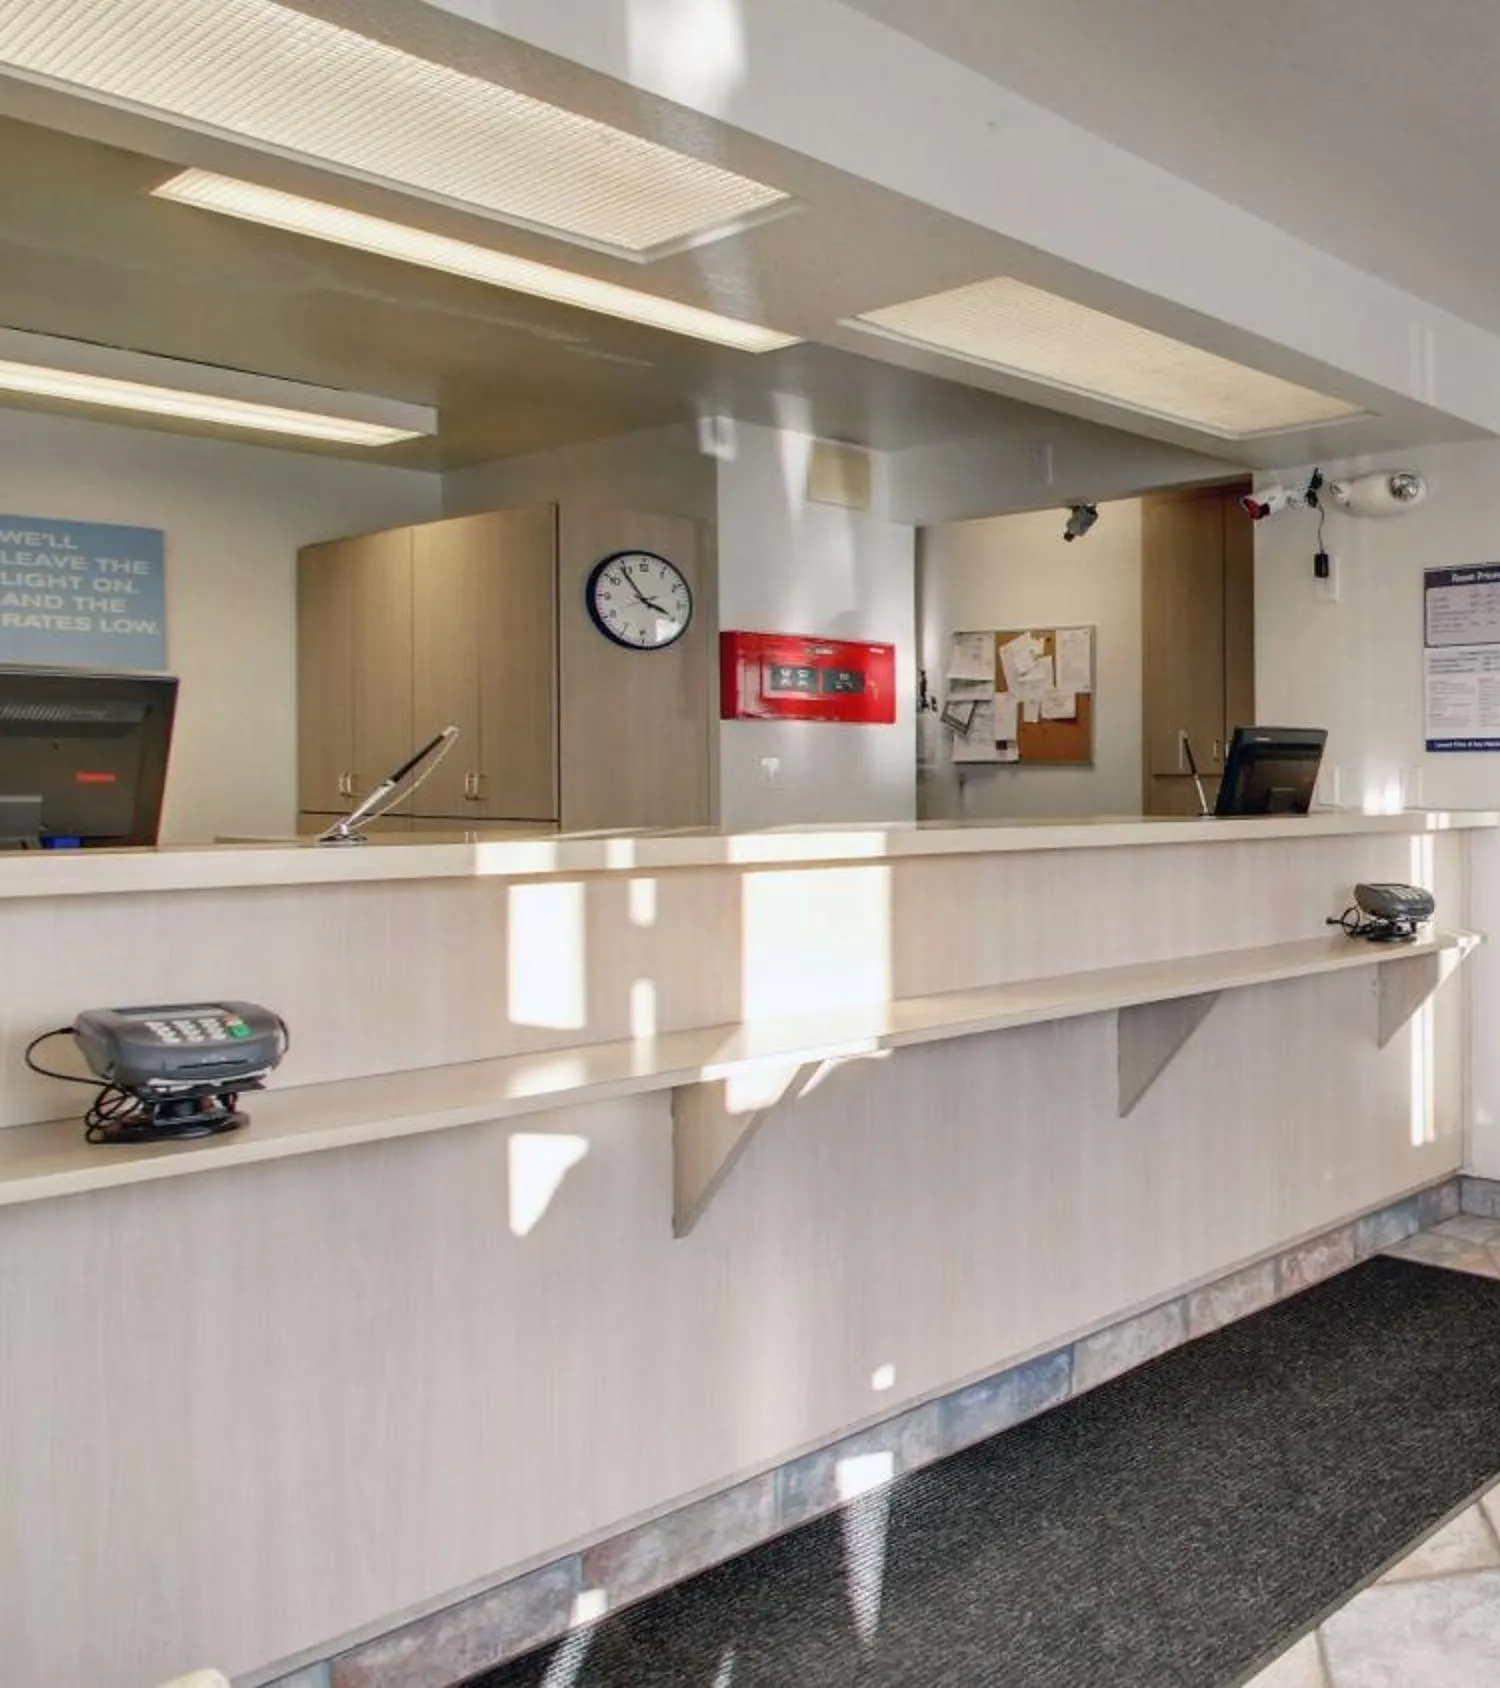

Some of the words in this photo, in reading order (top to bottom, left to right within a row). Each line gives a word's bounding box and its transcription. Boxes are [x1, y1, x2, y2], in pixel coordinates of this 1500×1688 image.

[0, 530, 79, 550] WE'LL
[0, 551, 89, 571] LEAVE
[94, 557, 152, 576] THE
[0, 572, 84, 590] LIGHT
[93, 577, 141, 594] ON.
[0, 591, 64, 610] AND
[72, 595, 128, 614] THE
[0, 612, 93, 632] RATES
[99, 619, 161, 636] LOW.
